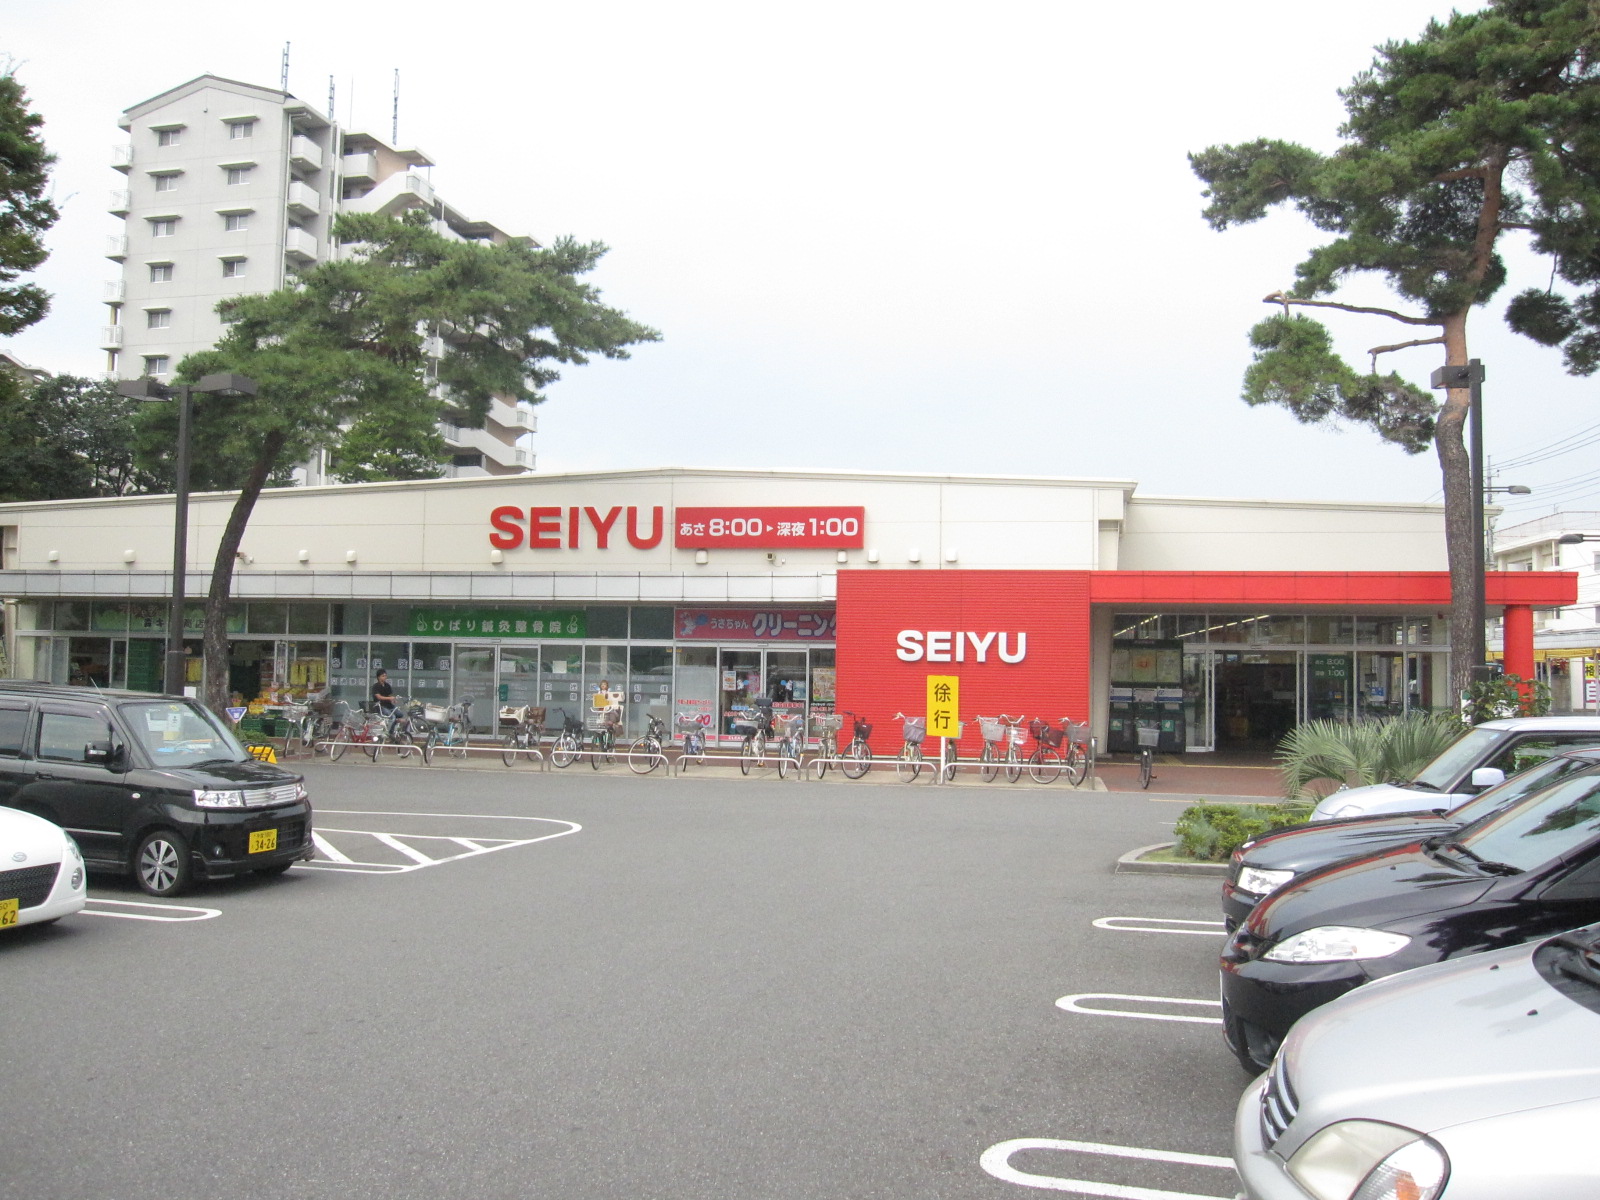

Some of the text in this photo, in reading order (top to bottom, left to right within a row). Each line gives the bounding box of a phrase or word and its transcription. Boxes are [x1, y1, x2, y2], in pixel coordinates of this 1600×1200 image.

[489, 505, 663, 550] SEIYU
[680, 517, 859, 537] あさ 8:00 深夜 1:00
[710, 617, 749, 630] うさちゃん
[896, 630, 1027, 664] SEIYU
[934, 682, 951, 730] 徐行
[255, 837, 275, 851] 34-26
